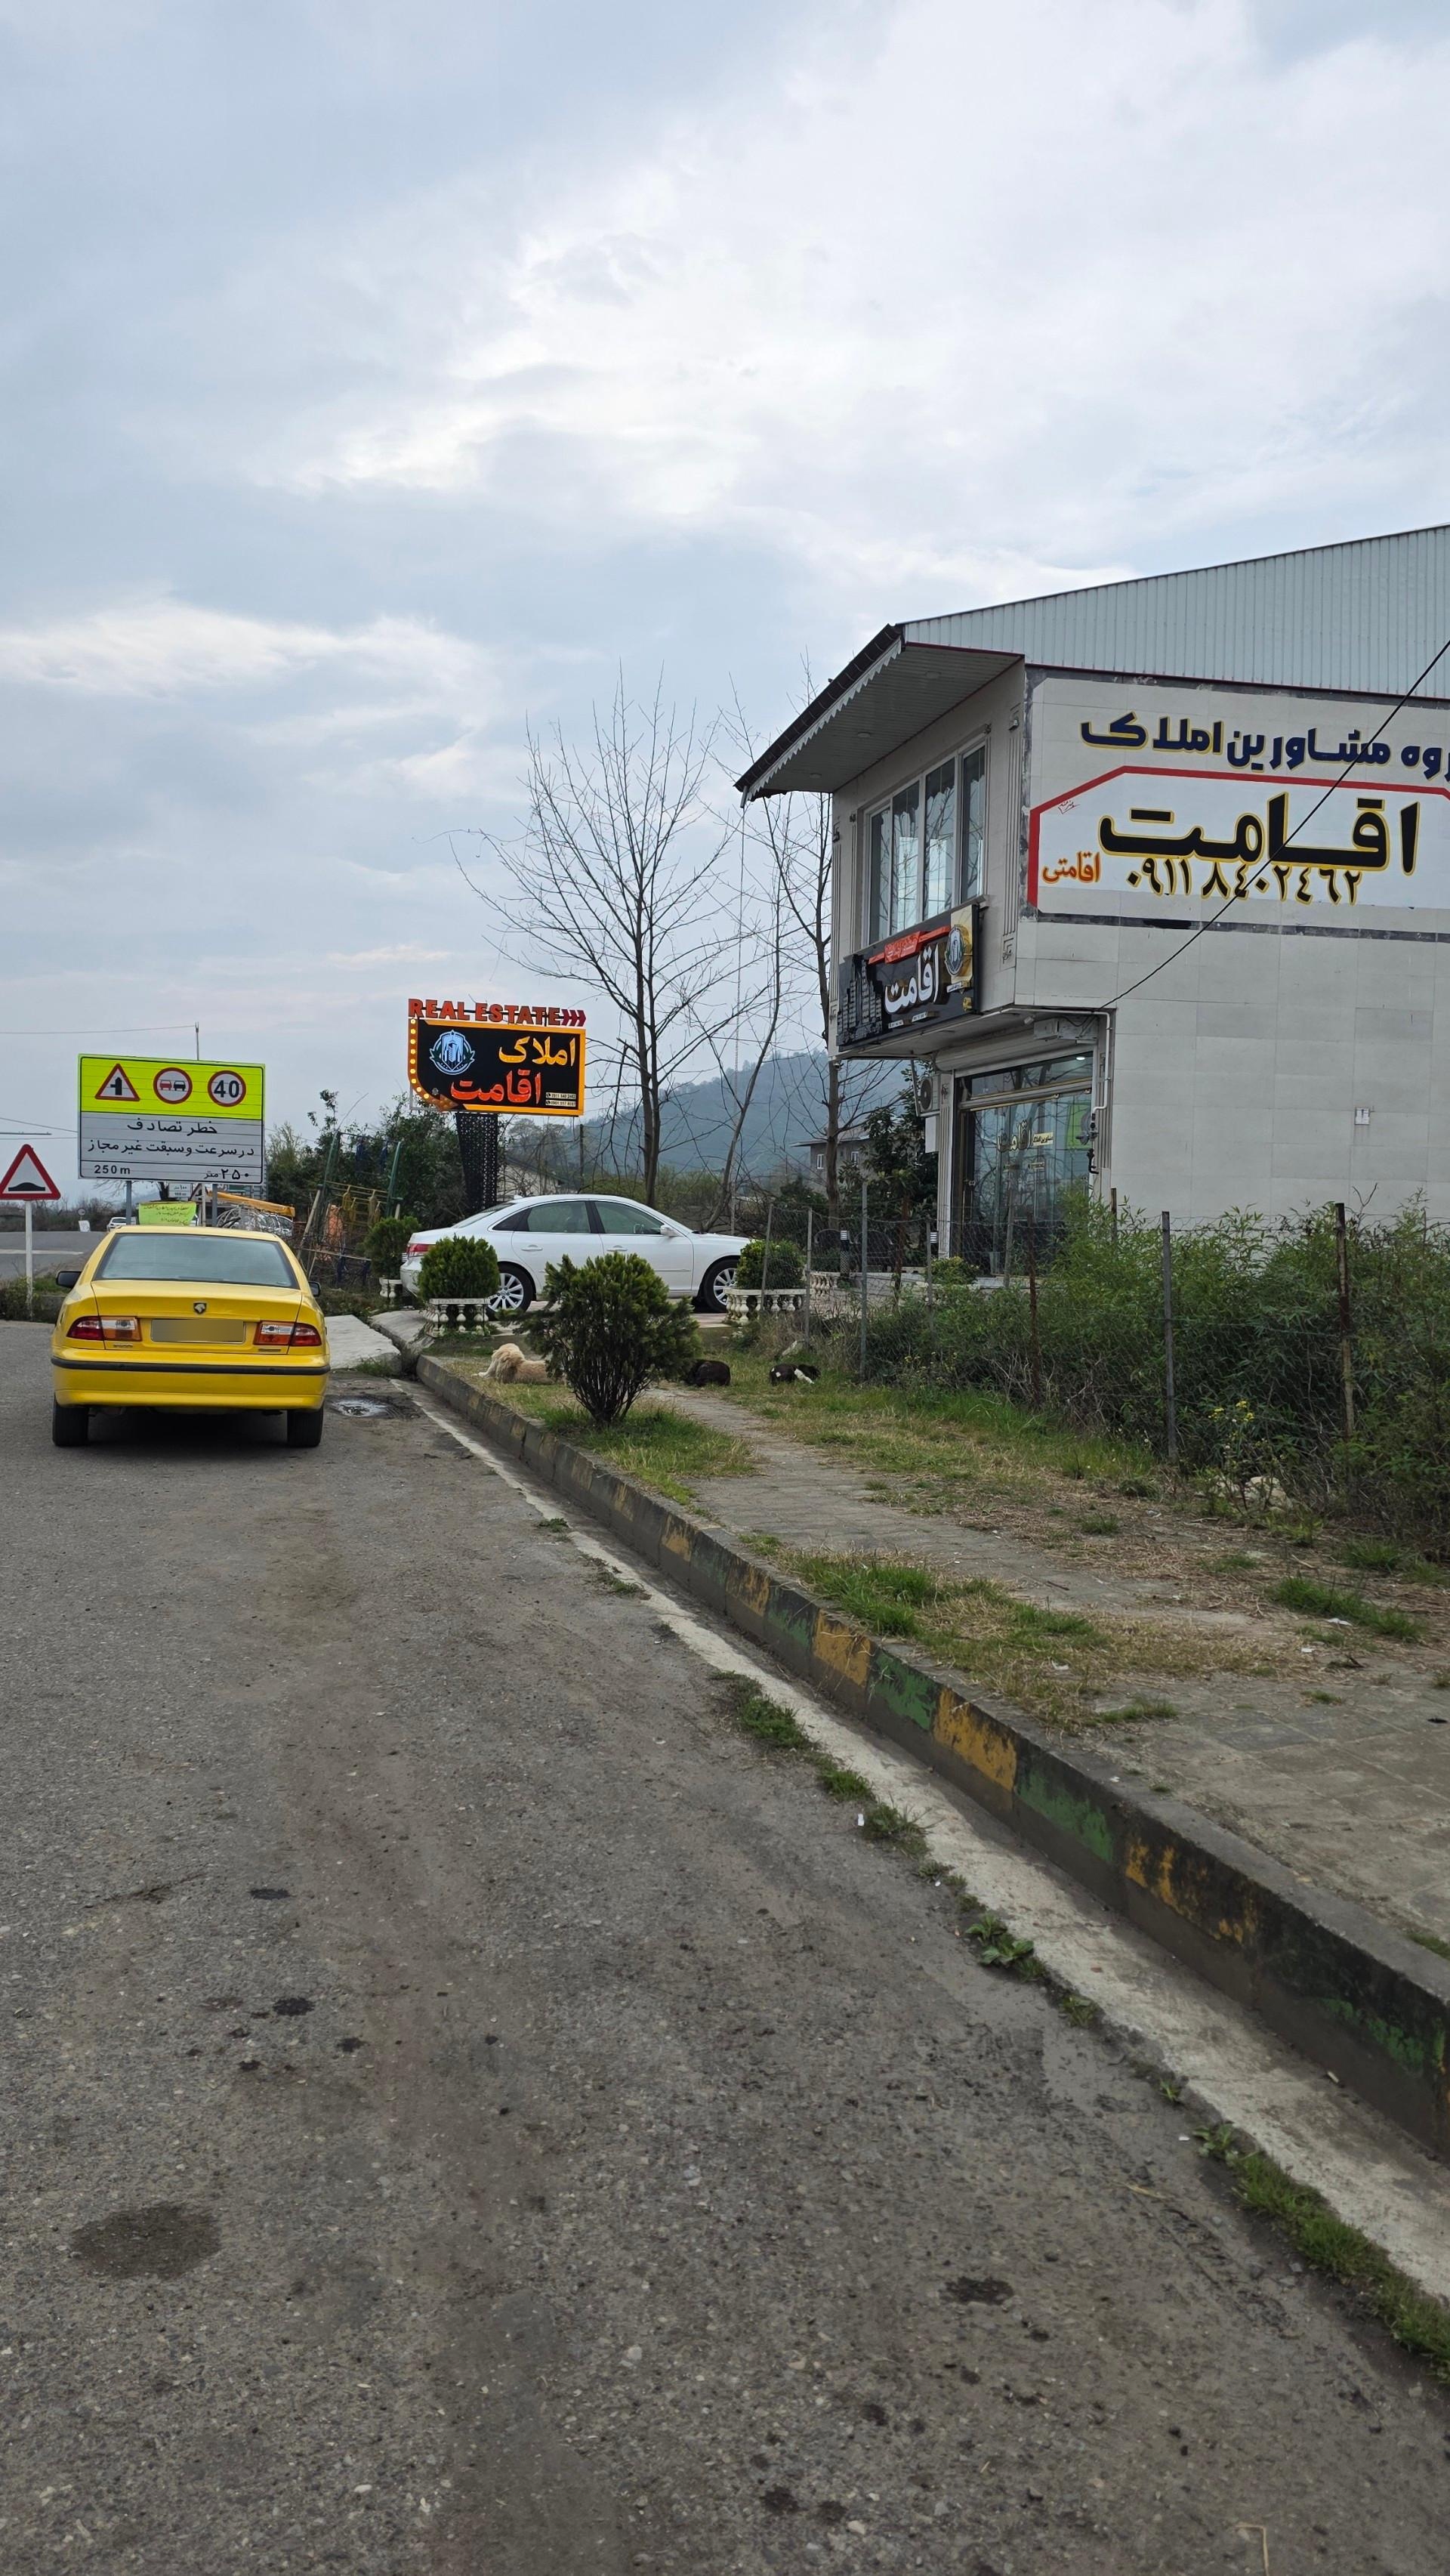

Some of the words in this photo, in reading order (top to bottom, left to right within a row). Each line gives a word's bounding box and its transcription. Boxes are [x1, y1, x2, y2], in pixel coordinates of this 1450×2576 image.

[1081, 712, 1222, 755] املاک
[1228, 728, 1391, 772] مشاورین
[1098, 792, 1420, 875] اقامت
[1042, 851, 1101, 883] اقامتی
[884, 944, 939, 1014] اقامت
[409, 998, 470, 1021] REAL
[474, 1002, 561, 1026] ESTATE
[498, 1036, 575, 1067] املاک
[214, 1080, 239, 1098] 40
[450, 1069, 541, 1104] اقامت
[127, 1118, 182, 1132] تصادف
[187, 1121, 218, 1135] خطر
[88, 1139, 119, 1152] مجاز
[94, 1164, 117, 1175] 250
[120, 1166, 131, 1175] m
[204, 1171, 219, 1179] متر
[221, 1168, 249, 1180] ۲۵۰
